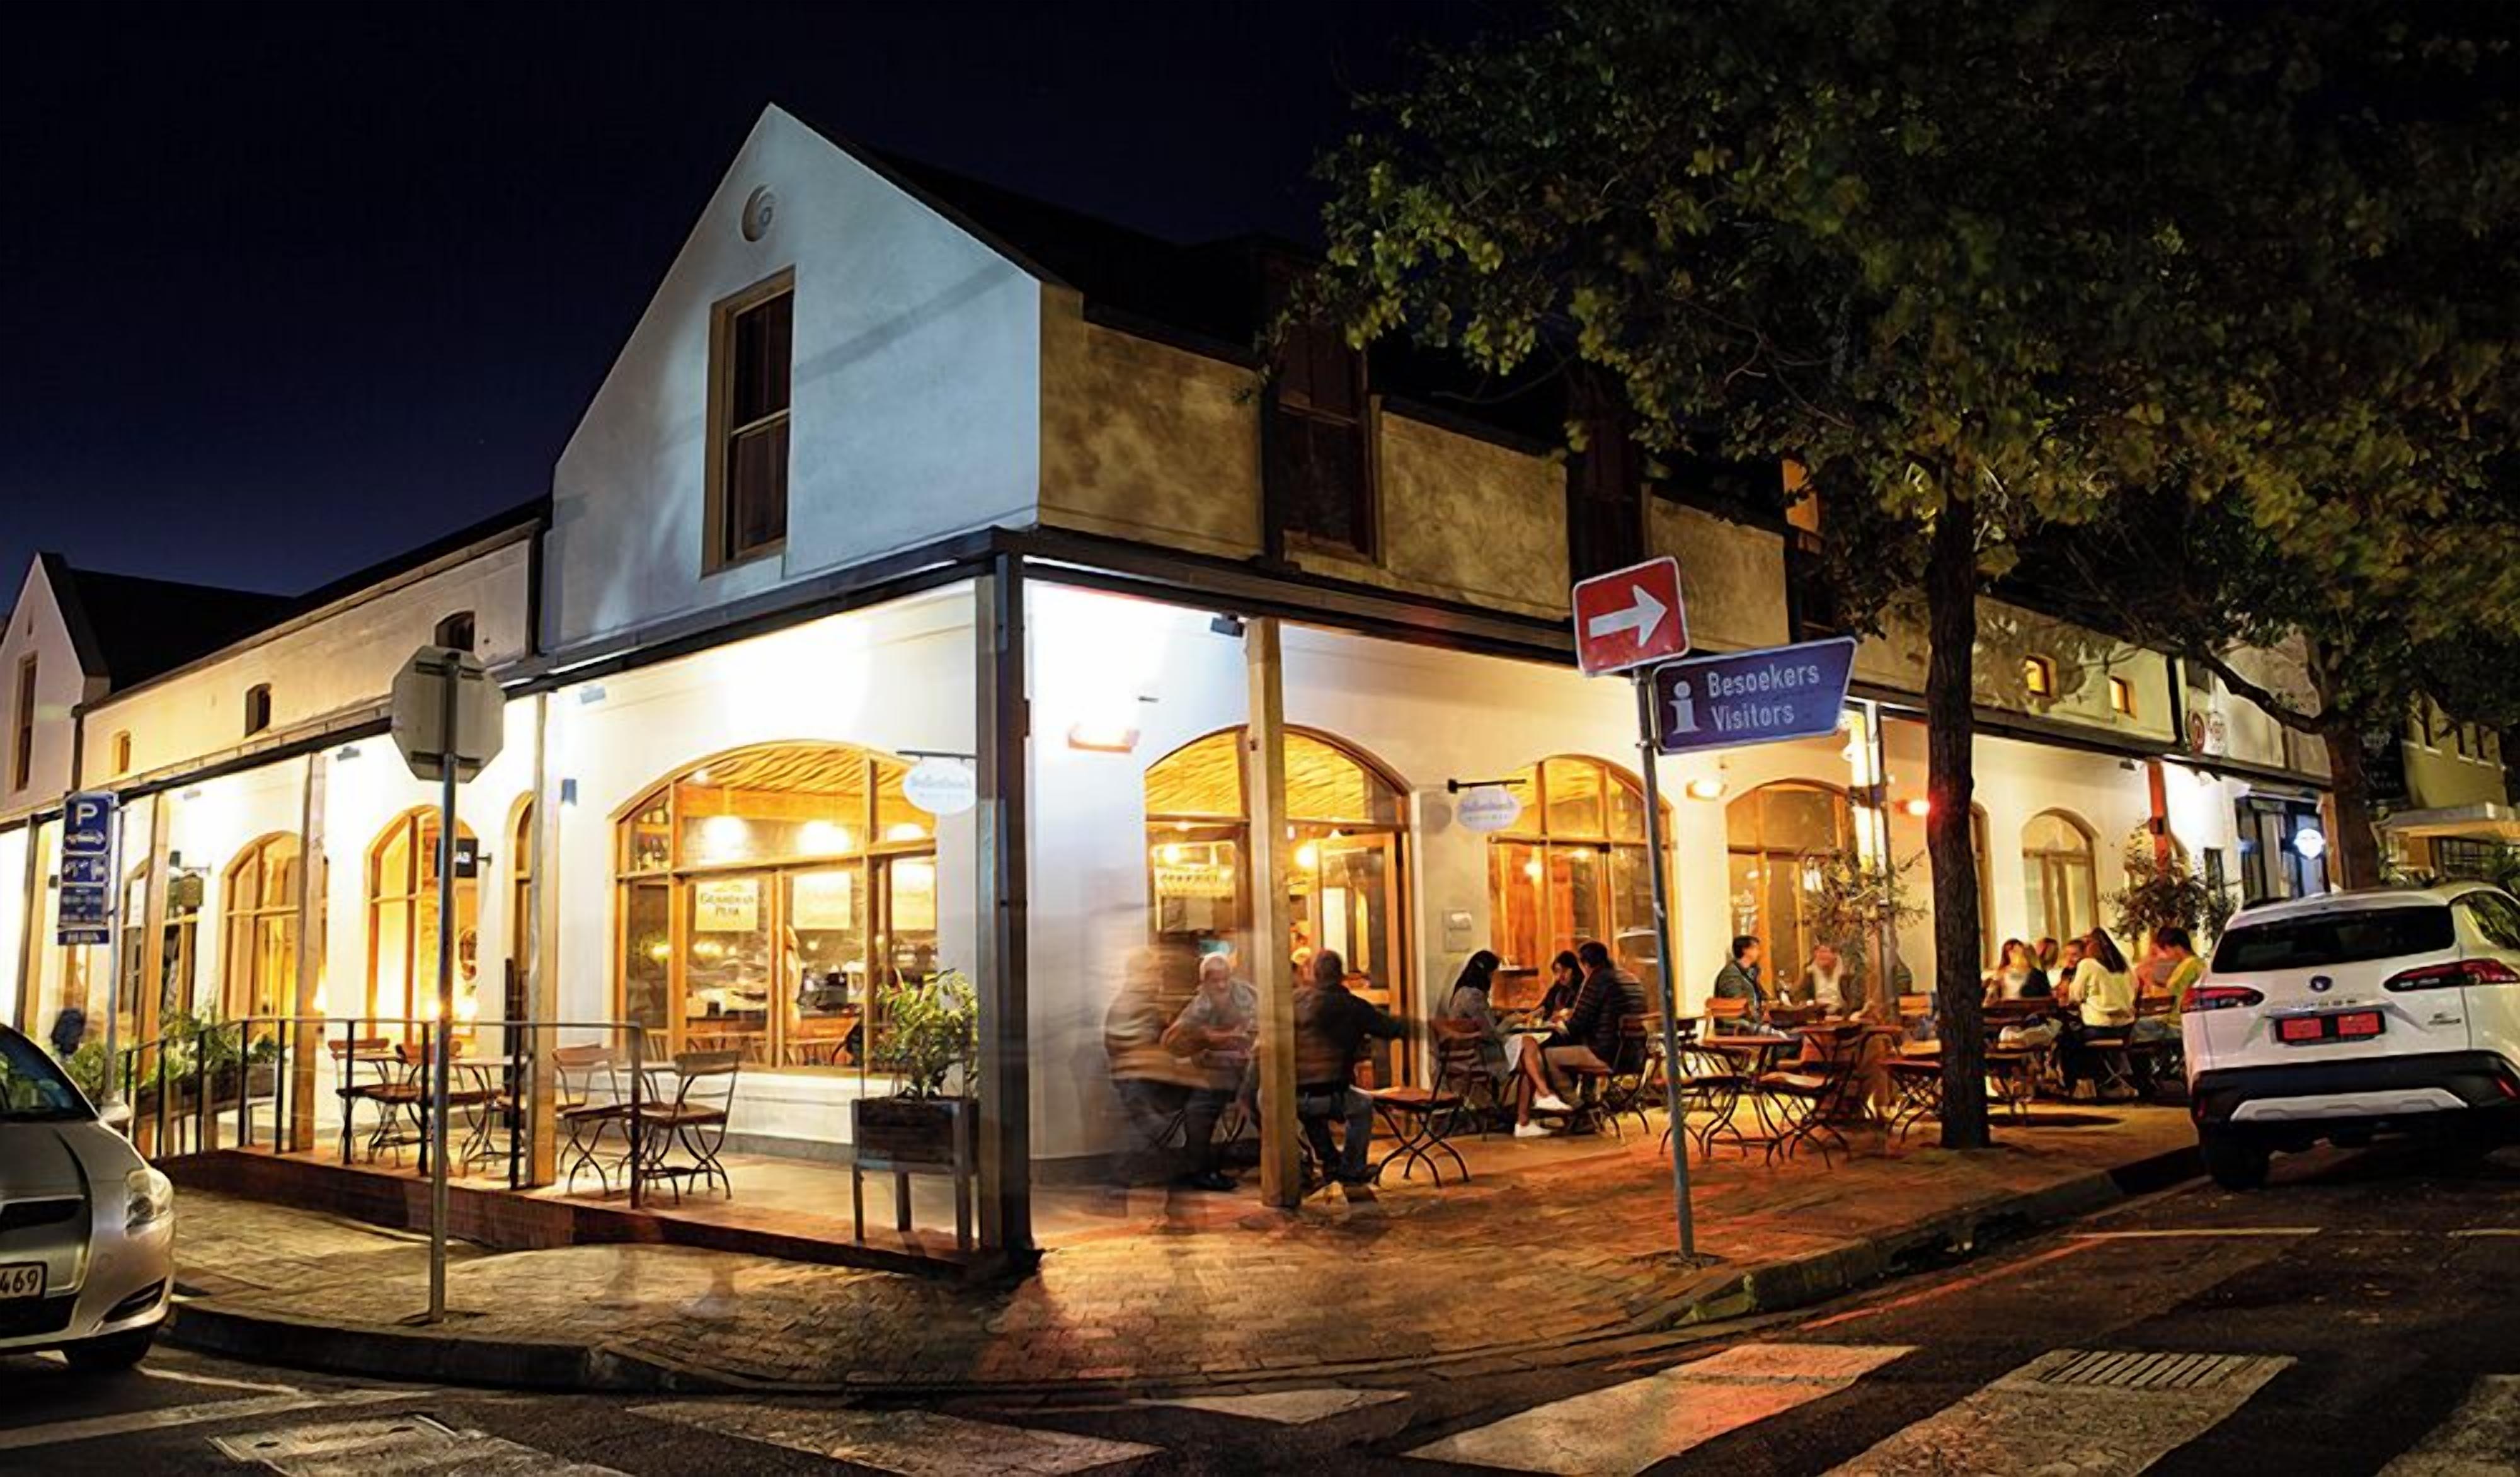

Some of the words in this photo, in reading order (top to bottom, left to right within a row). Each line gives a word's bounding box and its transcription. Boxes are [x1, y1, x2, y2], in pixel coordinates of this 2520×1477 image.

[1707, 664, 1821, 698] Besoekers
[1710, 704, 1795, 732] Visitors
[76, 803, 98, 827] P
